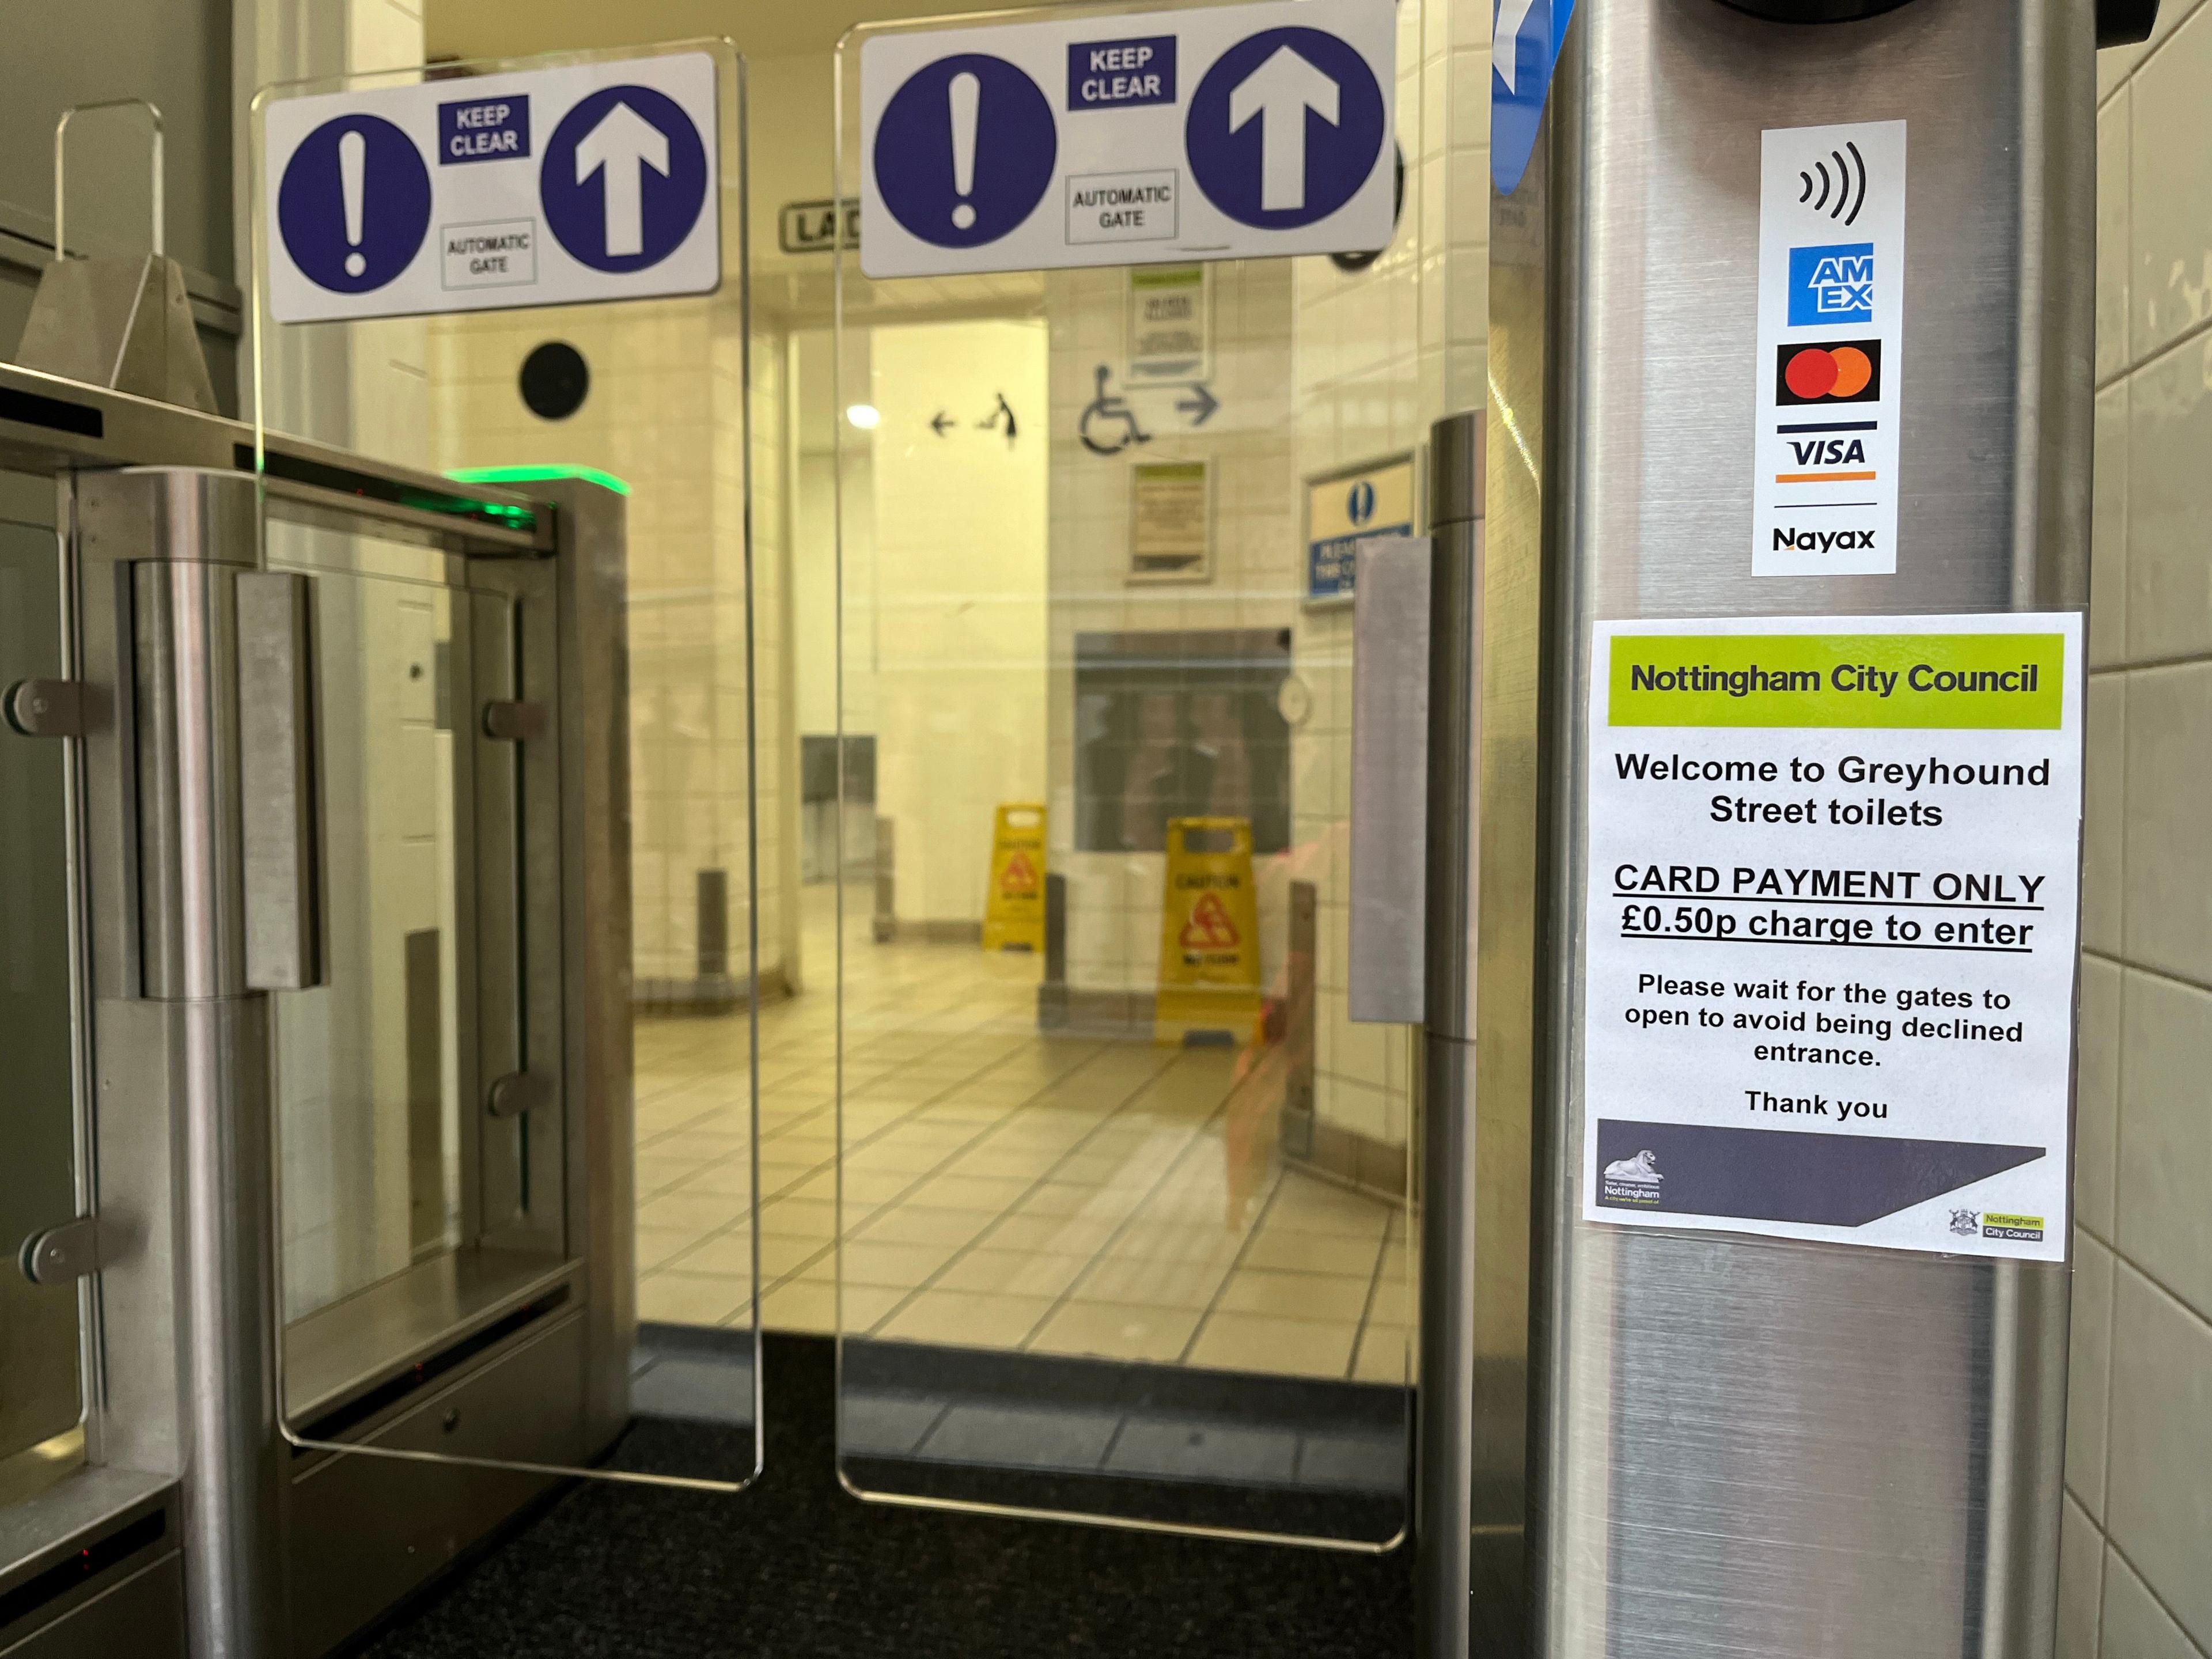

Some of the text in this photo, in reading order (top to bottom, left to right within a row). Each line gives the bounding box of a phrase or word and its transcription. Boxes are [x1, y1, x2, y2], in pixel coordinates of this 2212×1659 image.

[1090, 47, 1153, 72] KEEP
[1081, 75, 1161, 101] CLEAR
[457, 104, 510, 130] KEEP
[450, 130, 518, 157] CLEAR
[1073, 186, 1172, 207] AUTOMATIC
[1099, 210, 1144, 228] GATE
[448, 233, 531, 255] AUTOMATIC
[469, 256, 509, 275] GATE
[1787, 439, 1865, 465] VISA
[1773, 528, 1875, 553] Nayax
[1632, 664, 2037, 697] Nottingham City Council
[1615, 754, 2049, 791] Welcome to Greyhound
[1711, 796, 1942, 826] Street toilets
[1615, 865, 2045, 902] CARD PAYMENT ONLY
[1621, 905, 2033, 946] £0.50p charge to enter
[1639, 974, 2010, 1010] Please wait for the gates to
[1626, 1008, 2022, 1041] open to avoid being declined
[1755, 1042, 1882, 1066] entrance.
[1745, 1091, 1887, 1121] Thank you
[1605, 1186, 1659, 1198] Nottingham
[1986, 1214, 2040, 1226] Nottingham
[1986, 1228, 2040, 1239] City Council
